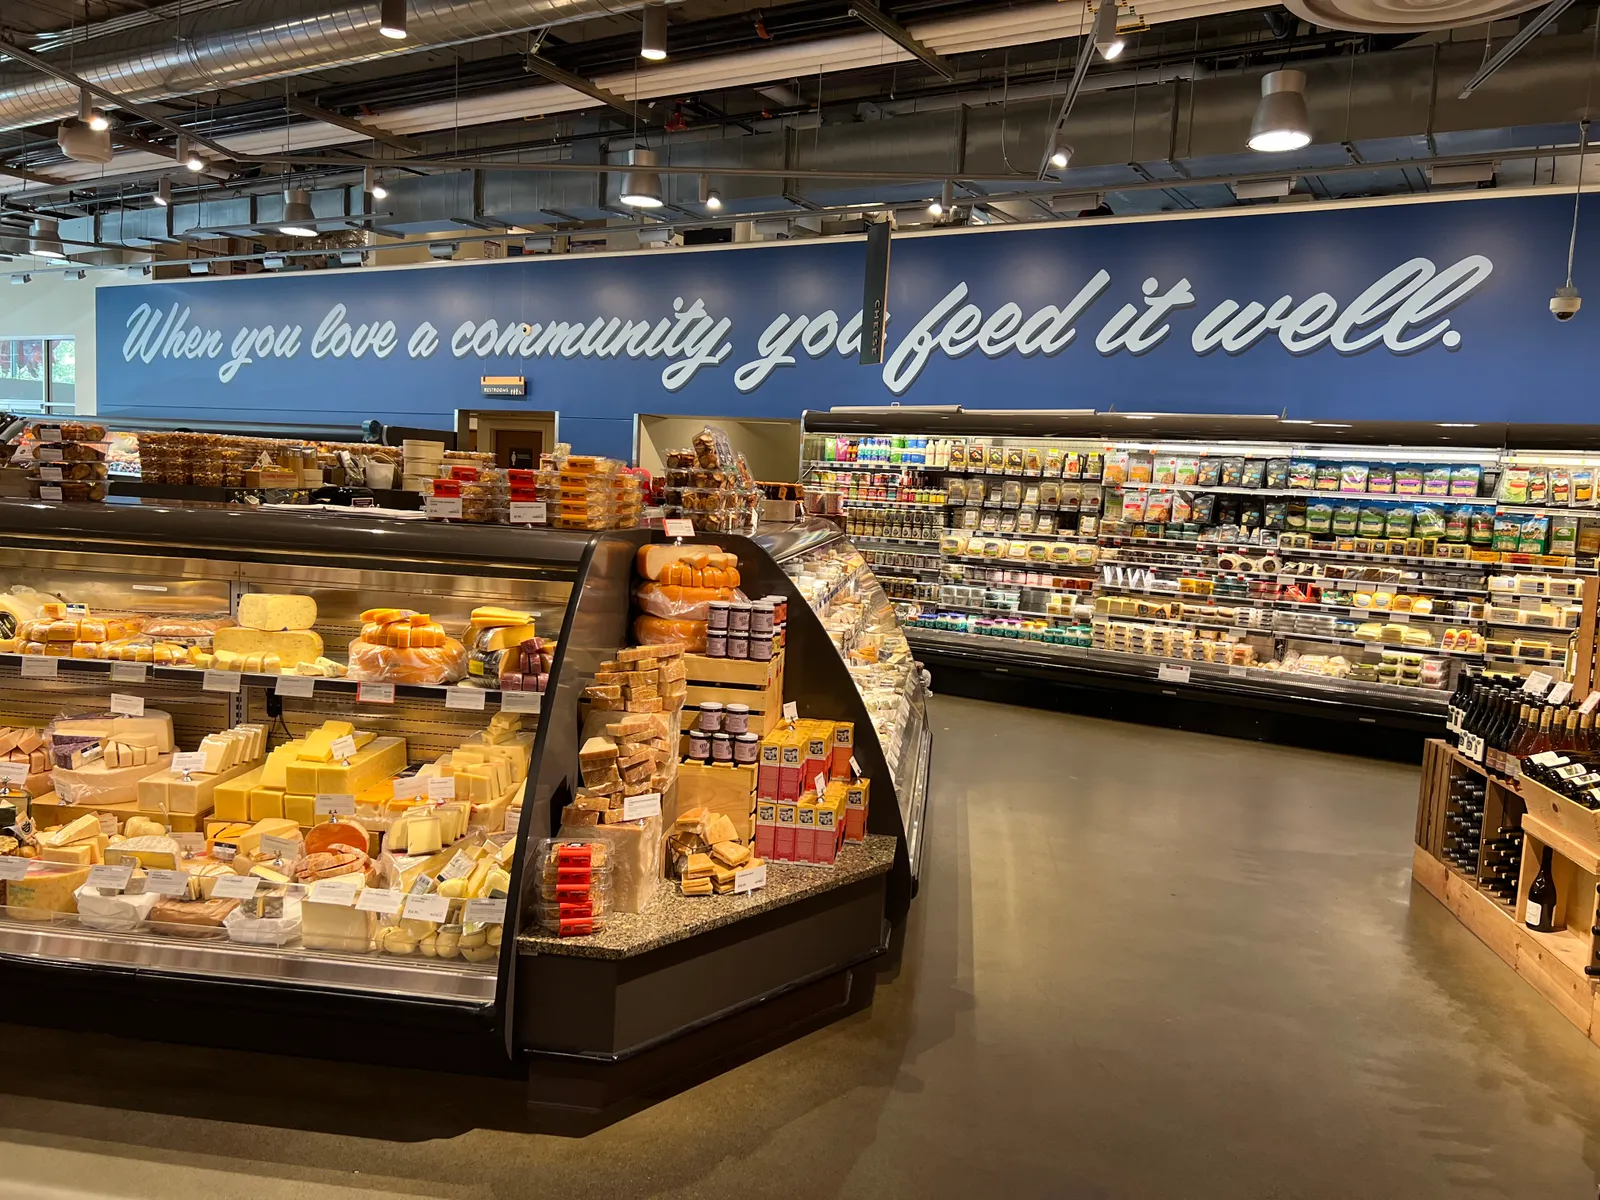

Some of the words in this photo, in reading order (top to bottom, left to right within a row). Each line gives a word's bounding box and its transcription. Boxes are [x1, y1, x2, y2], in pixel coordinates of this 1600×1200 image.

[123, 302, 223, 364] When
[219, 325, 303, 384] you
[311, 303, 398, 359] love
[407, 320, 440, 358] a
[450, 297, 732, 390] community,
[882, 269, 1111, 393] feed
[1096, 277, 1195, 353] it
[1191, 254, 1494, 353] well.
[871, 299, 881, 356] CHEESE
